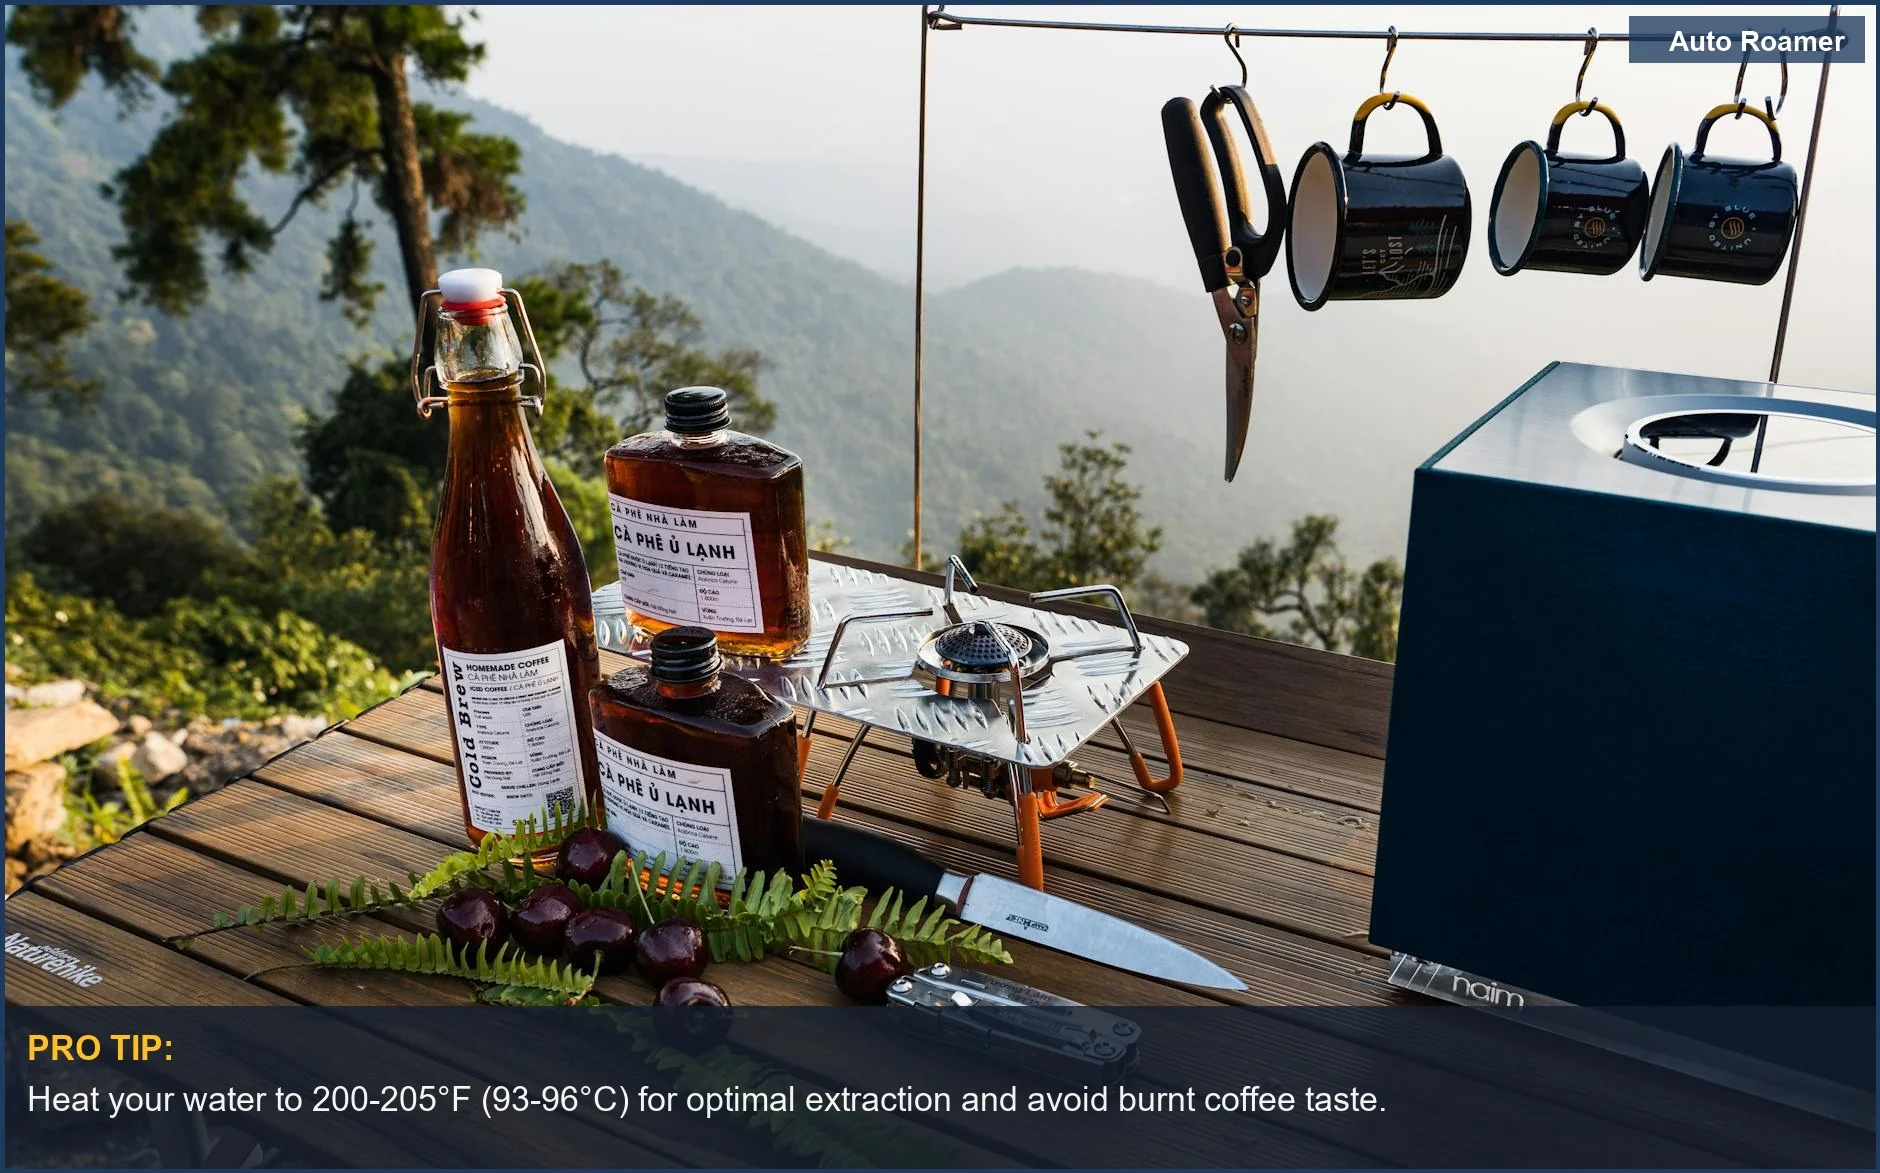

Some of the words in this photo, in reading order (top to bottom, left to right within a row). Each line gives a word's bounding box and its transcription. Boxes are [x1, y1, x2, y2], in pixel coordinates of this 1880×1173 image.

[1724, 204, 1756, 220] BLUE
[1362, 248, 1376, 275] LET'S
[1388, 236, 1403, 260] LOST
[610, 502, 622, 513] CÀ
[625, 507, 642, 519] PHÊ
[646, 513, 669, 525] NHÀ
[674, 517, 697, 528] LÀM
[614, 525, 632, 544] CÀ
[636, 532, 664, 551] PHÊ
[670, 535, 680, 554] Ủ
[686, 542, 736, 562] LẠNH
[466, 663, 515, 672] HOMEMADE
[518, 656, 550, 669] COFFEE
[468, 673, 480, 681] CÀ
[482, 673, 497, 681] PHÊ
[499, 673, 518, 681] NHÀ
[520, 669, 538, 678] LÀM
[452, 661, 472, 728] Brew
[463, 737, 482, 789] Cold
[607, 746, 622, 761] PHÊ
[626, 756, 648, 771] NHÀ
[653, 763, 676, 779] LÀM
[599, 761, 614, 782] CÀ
[618, 773, 644, 797] PHÊ
[649, 782, 659, 802] Ủ
[666, 792, 715, 814] LẠNH
[4, 932, 103, 988] Naturehike
[1452, 975, 1524, 1011] naim
